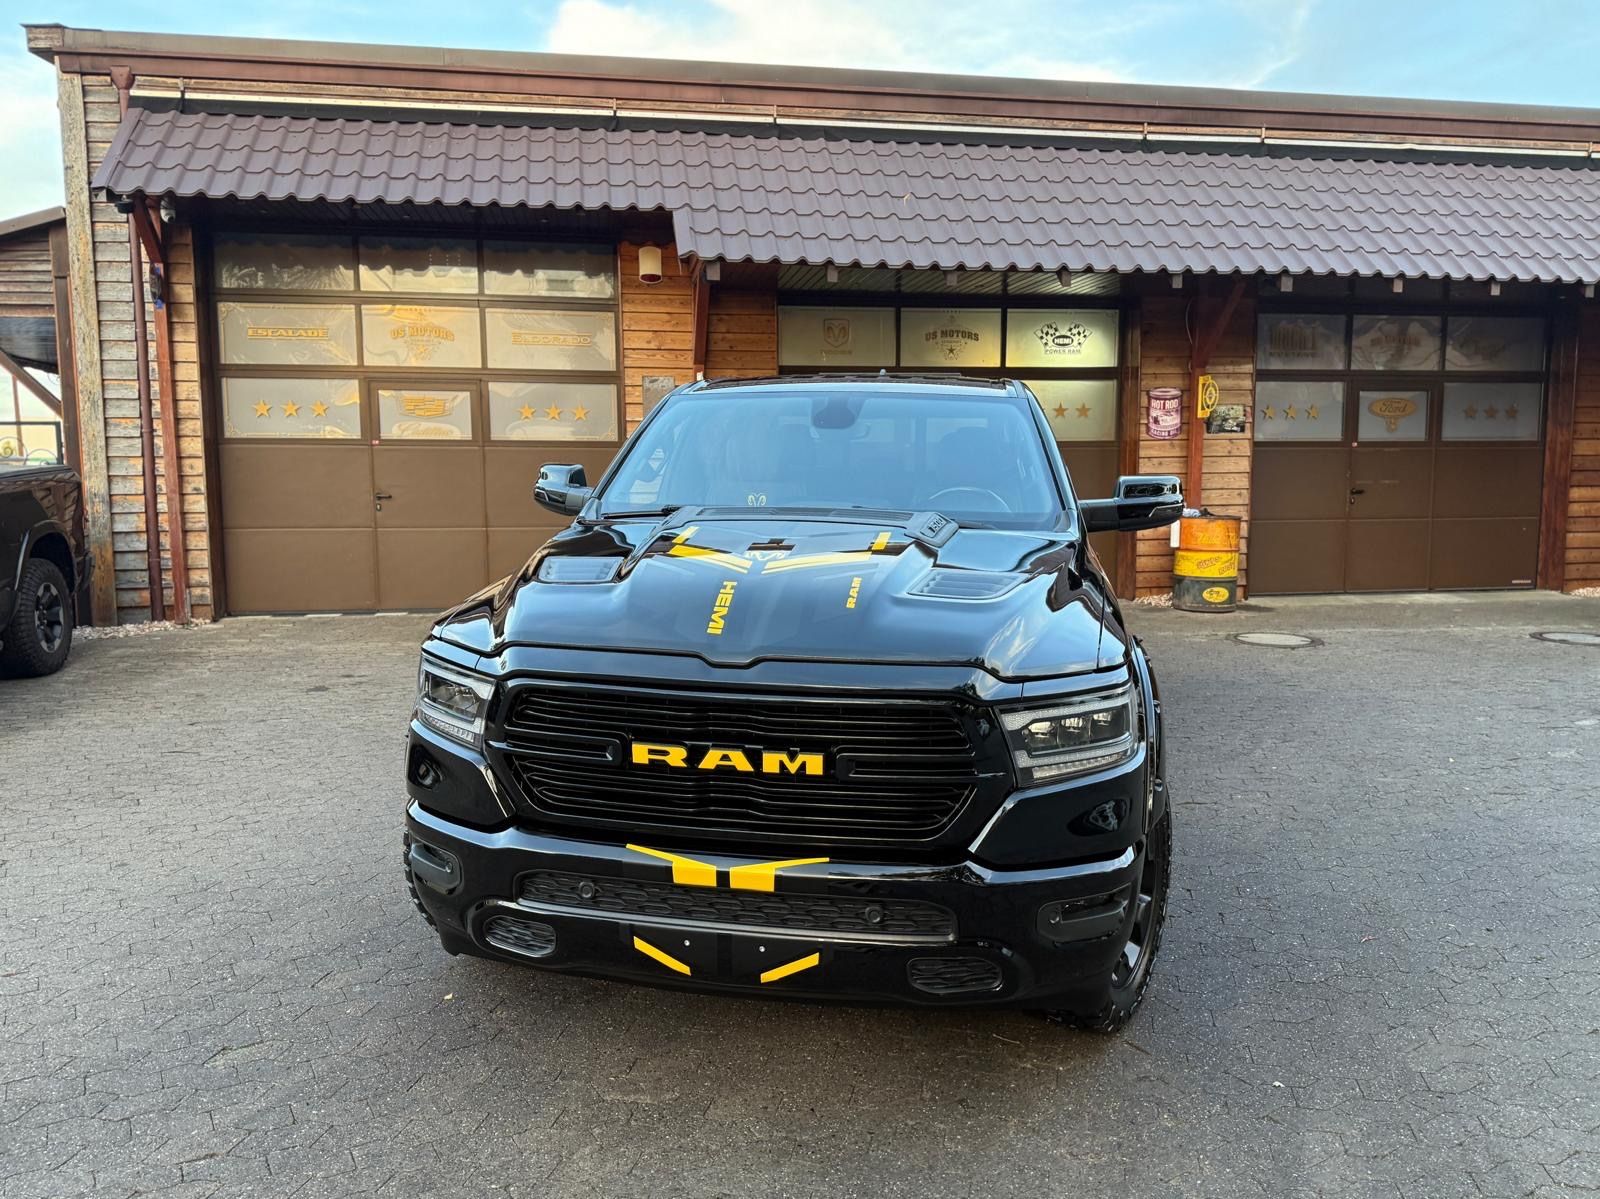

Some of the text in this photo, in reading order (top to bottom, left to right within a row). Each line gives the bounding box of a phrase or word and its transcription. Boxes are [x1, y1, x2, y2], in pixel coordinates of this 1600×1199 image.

[248, 328, 328, 337] ESCALADE
[409, 326, 455, 341] MOTORS
[925, 329, 980, 341] US MOTORS
[1053, 337, 1072, 345] HEMI
[1151, 399, 1179, 409] HOT ROD
[845, 577, 862, 609] RAM
[706, 581, 738, 635] HEMI
[631, 742, 824, 776] RAM
